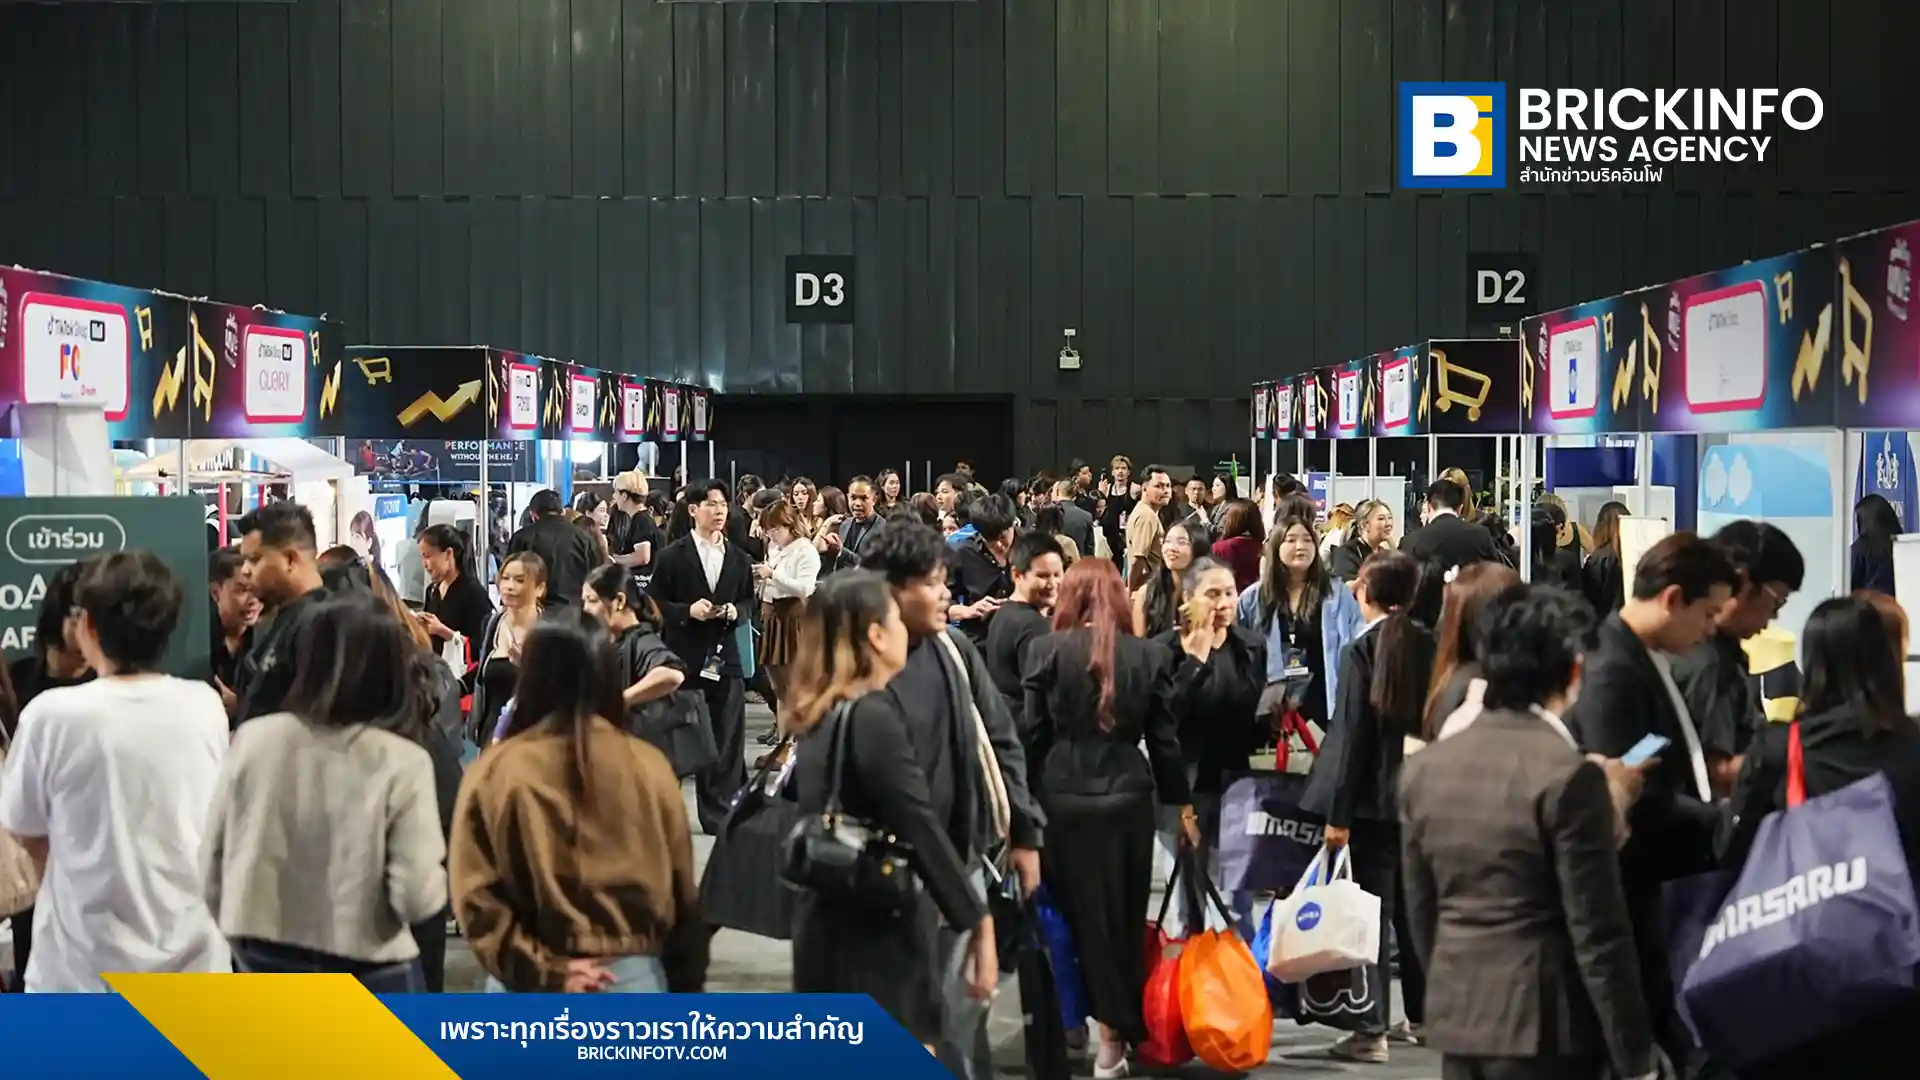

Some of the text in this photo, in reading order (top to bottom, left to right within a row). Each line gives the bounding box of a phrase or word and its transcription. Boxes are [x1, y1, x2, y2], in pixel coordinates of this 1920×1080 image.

[795, 273, 844, 307] D3
[1477, 270, 1526, 304] D2
[450, 453, 482, 461] WITHOU
[28, 527, 104, 549] เข้าร่วม
[1699, 856, 1868, 960] MASARU
